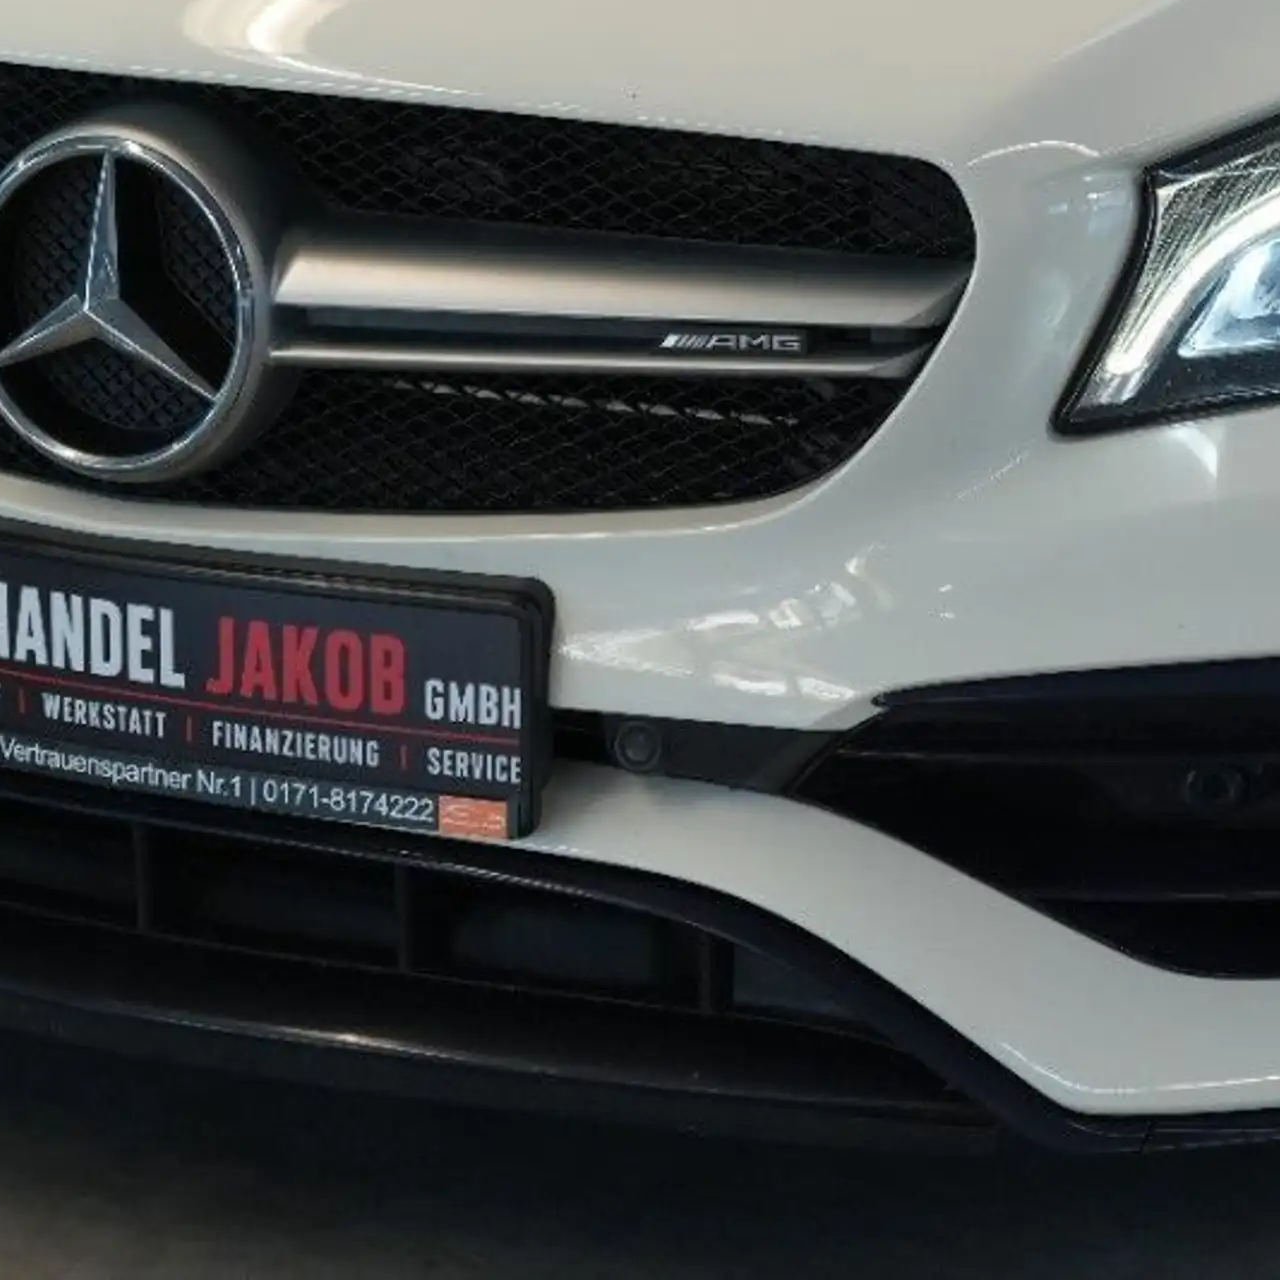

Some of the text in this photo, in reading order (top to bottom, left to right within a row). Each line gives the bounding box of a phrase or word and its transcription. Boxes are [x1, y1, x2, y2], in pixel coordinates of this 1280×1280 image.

[206, 616, 406, 715] JAKOB
[424, 677, 521, 730] GMBH
[0, 734, 192, 790] Vertrauenspartner
[196, 769, 242, 798] Nr.1
[262, 780, 436, 823] 0171-8174222
[41, 692, 167, 738] WERKSTATT
[212, 721, 380, 768] FINANZIERUNG
[426, 746, 521, 783] SERVICE
